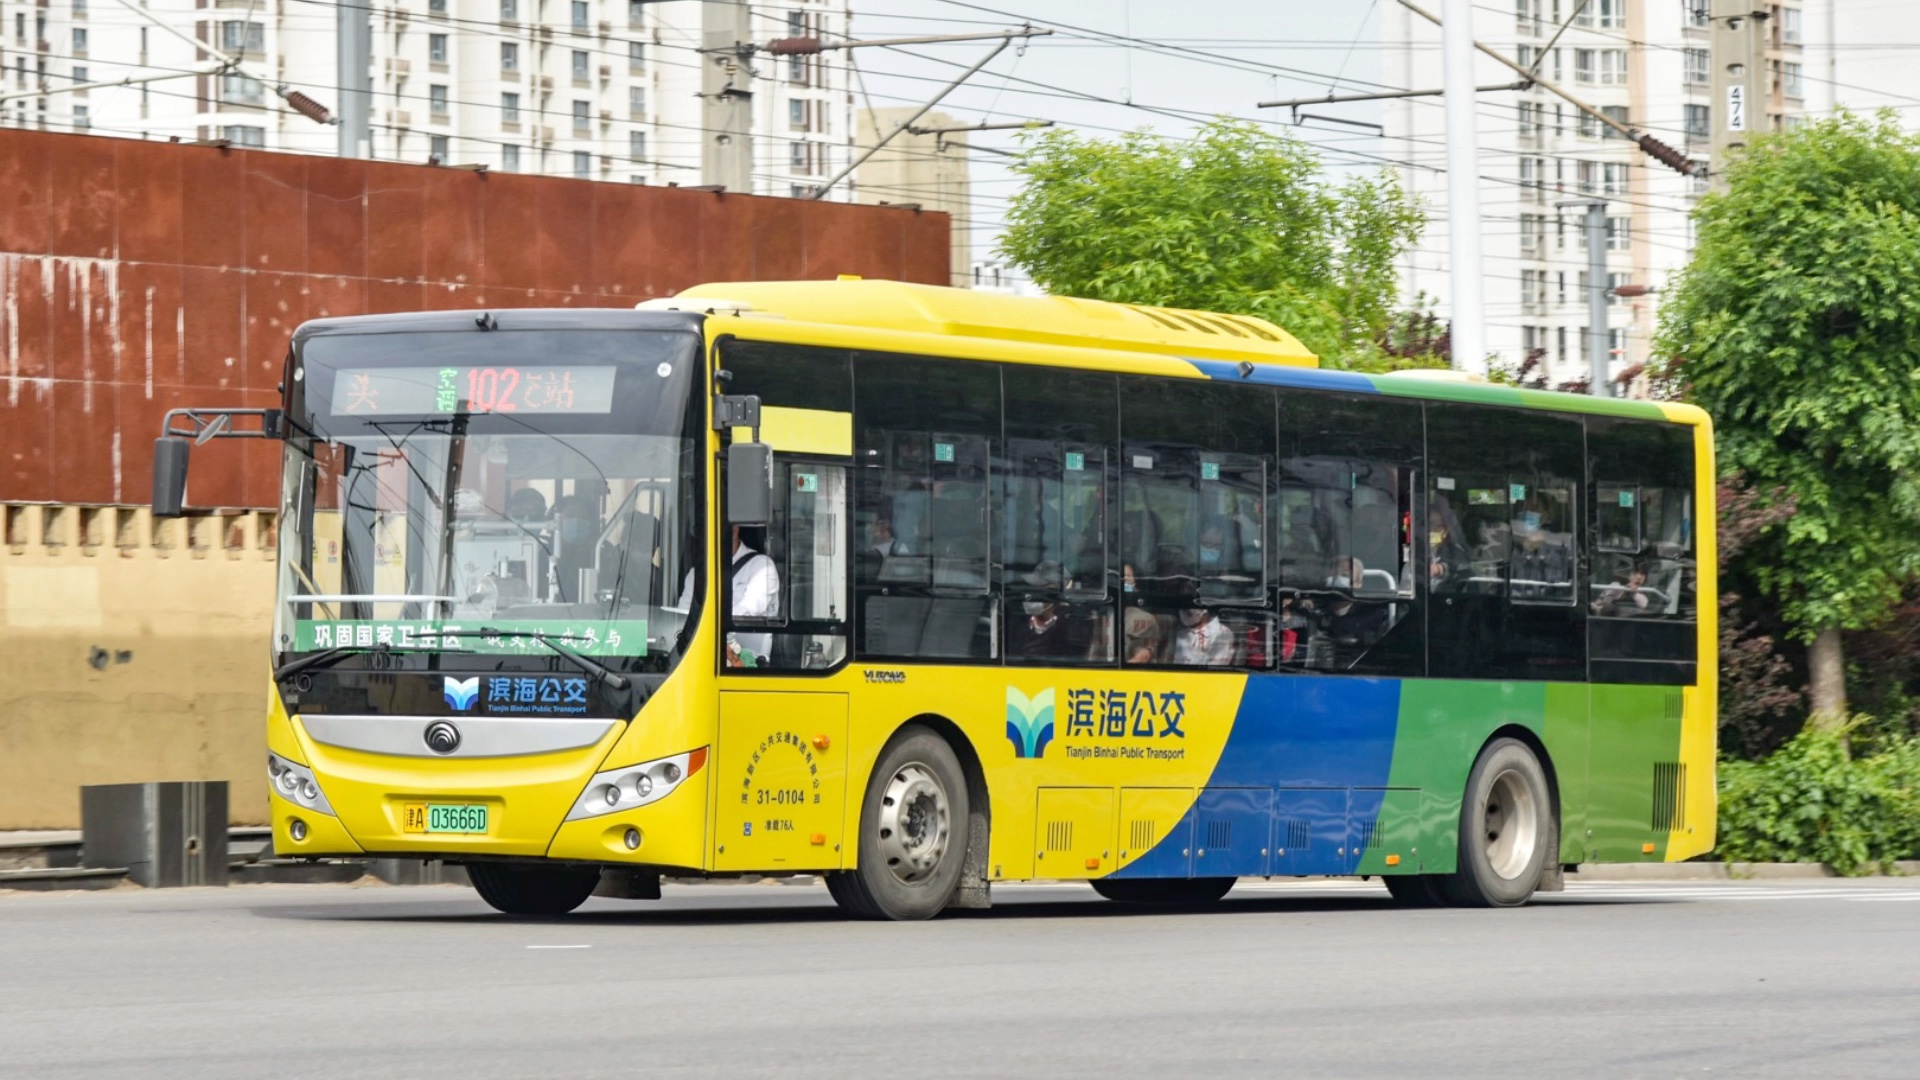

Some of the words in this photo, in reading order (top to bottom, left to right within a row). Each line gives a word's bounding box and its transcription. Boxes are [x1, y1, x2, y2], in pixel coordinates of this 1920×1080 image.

[1731, 87, 1741, 128] 474
[467, 368, 520, 411] 102
[314, 625, 462, 648] 巩固国家卫生区
[488, 677, 586, 703] 滨海公交
[488, 705, 509, 713] Tianjin
[1066, 688, 1185, 738] 滨海公交
[1066, 746, 1092, 760] Tianjin
[1094, 747, 1118, 758] Binhai
[1120, 747, 1144, 758] Public
[1146, 748, 1184, 761] Transport
[757, 789, 804, 804] 31-0104
